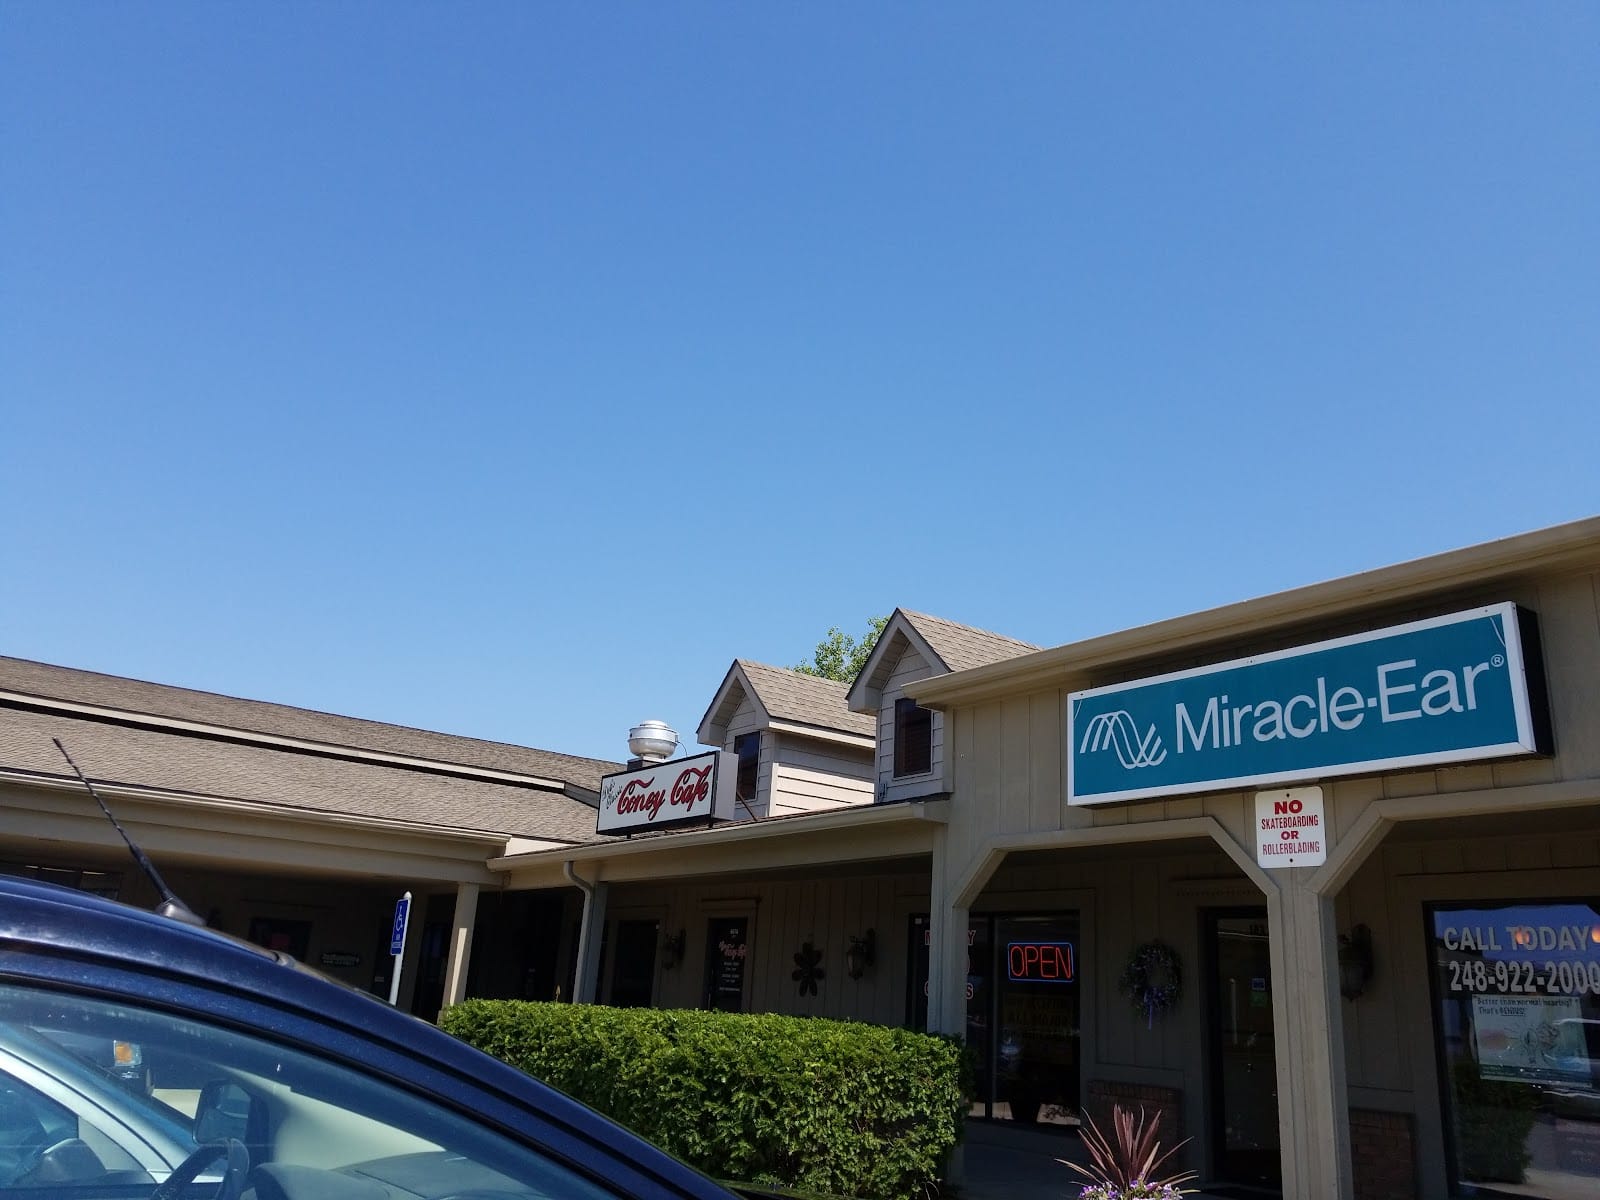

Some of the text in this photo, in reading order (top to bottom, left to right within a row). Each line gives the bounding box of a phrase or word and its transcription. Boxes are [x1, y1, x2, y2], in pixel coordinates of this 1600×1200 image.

[616, 776, 666, 821] Coney
[1274, 799, 1303, 815] NO
[1261, 814, 1319, 830] SKATEBOARDING
[1281, 830, 1299, 841] OR
[1262, 841, 1320, 855] ROLLERBLADING
[1443, 926, 1590, 951] CALL TODAY
[1010, 945, 1071, 979] OPEN
[1449, 960, 1600, 995] 248-922-2000
